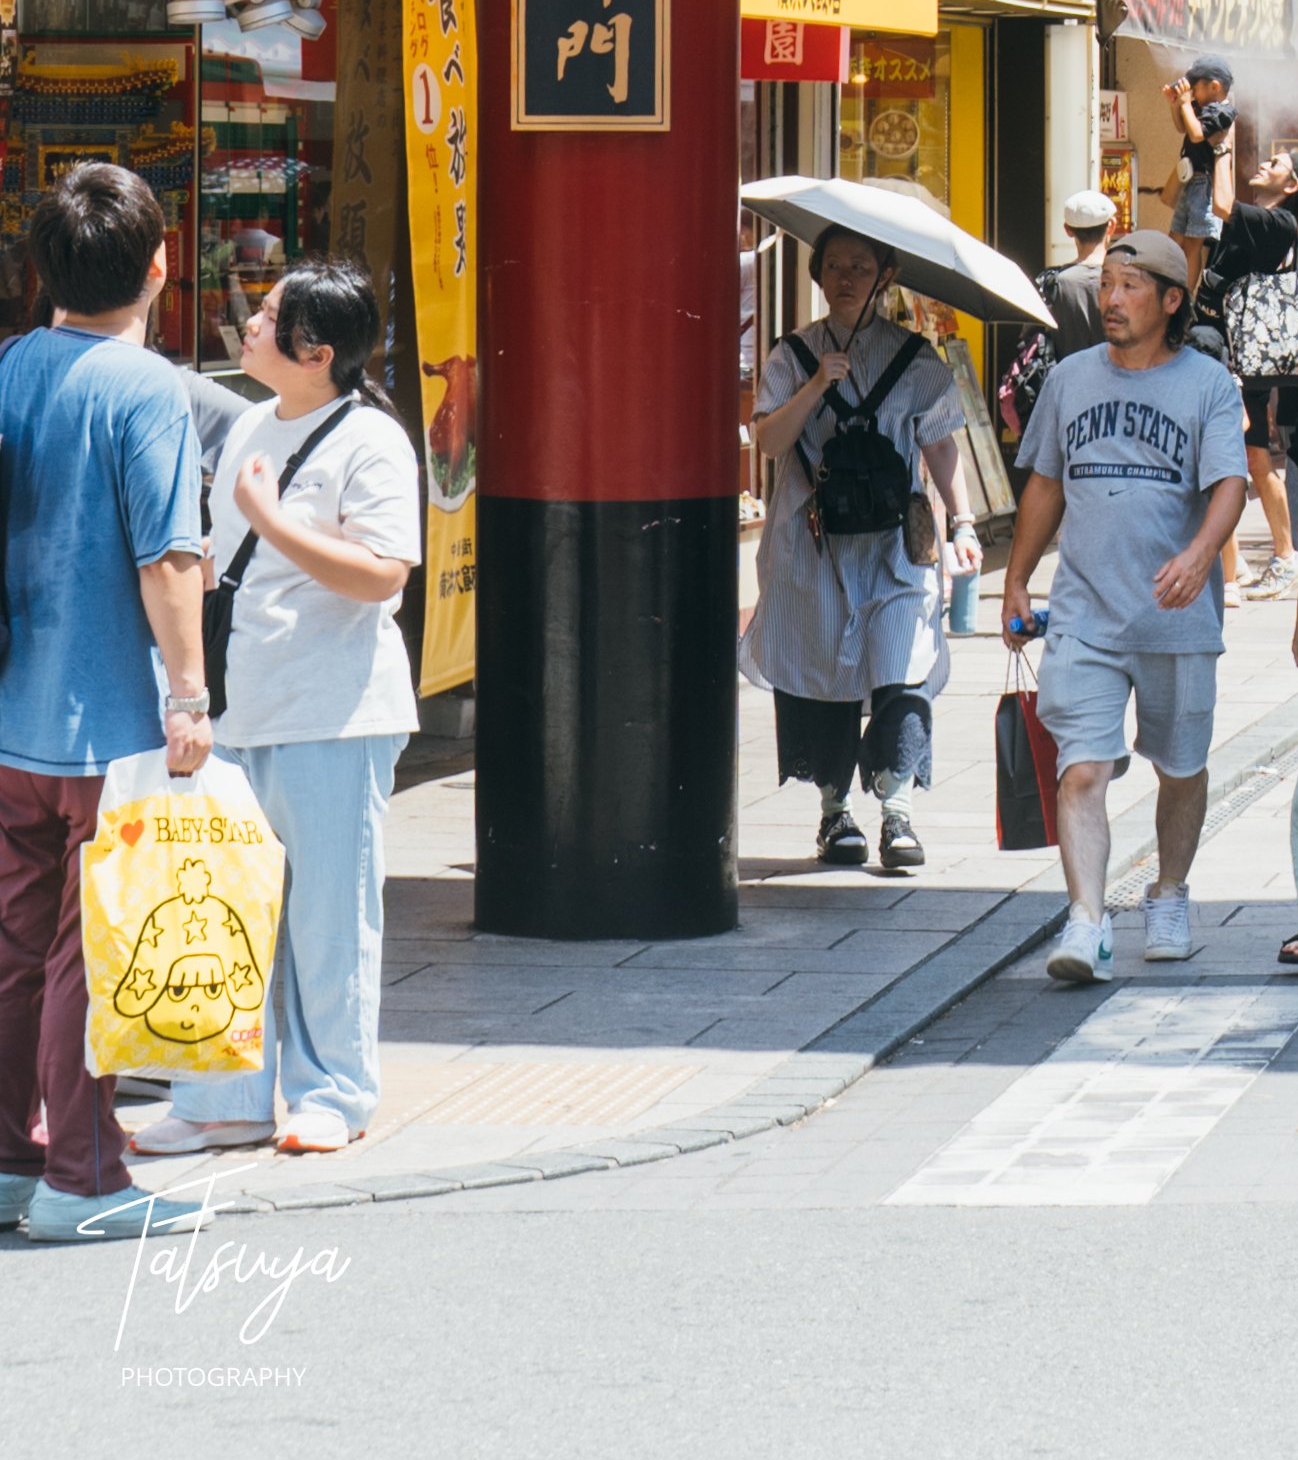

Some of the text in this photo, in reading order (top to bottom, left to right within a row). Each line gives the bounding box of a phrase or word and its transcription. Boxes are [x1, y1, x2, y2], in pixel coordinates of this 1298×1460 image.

[1066, 400, 1189, 468] PENN STATE
[1072, 464, 1123, 477] INTRAMURAL
[153, 816, 263, 846] BABY-STAR
